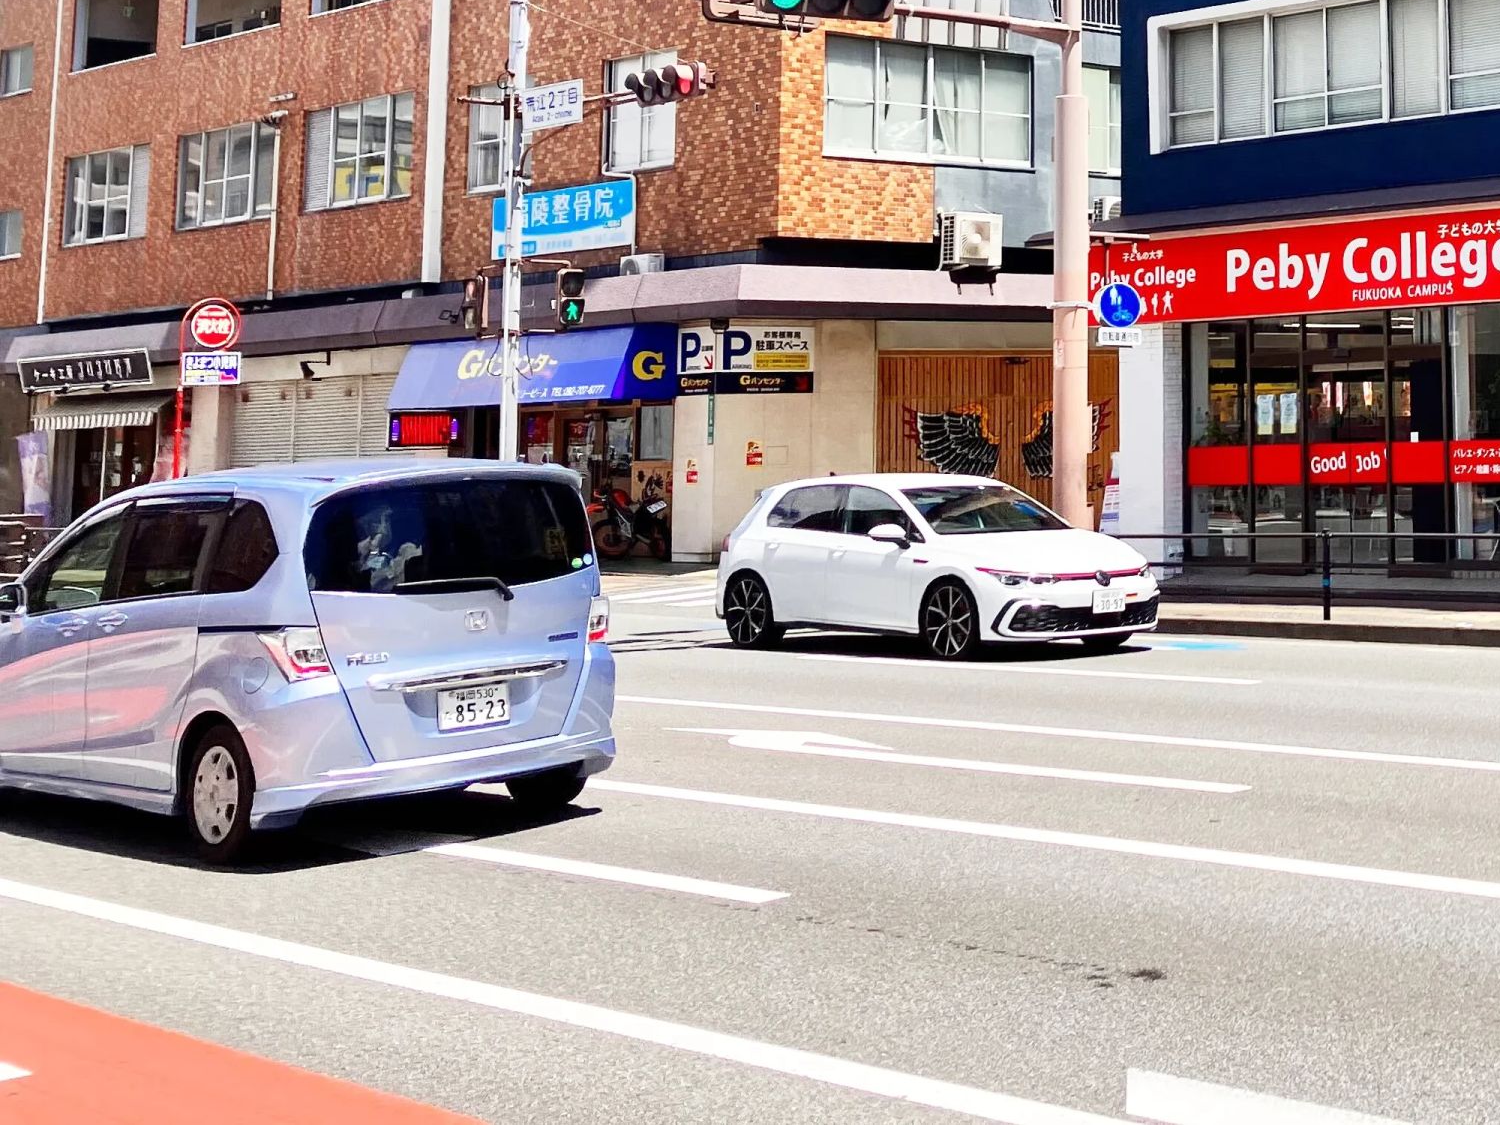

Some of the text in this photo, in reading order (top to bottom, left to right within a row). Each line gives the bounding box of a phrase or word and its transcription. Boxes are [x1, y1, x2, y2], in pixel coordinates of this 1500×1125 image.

[526, 88, 577, 112] 荒江2丁目
[1134, 266, 1196, 288] College
[1226, 243, 1331, 300] Peby
[1352, 281, 1454, 302] FUKUOKA CAMPUS
[680, 332, 701, 372] P
[723, 331, 752, 370] P
[755, 340, 809, 351] 駐車スペース
[632, 351, 666, 380] G
[1310, 451, 1381, 474] Good Job
